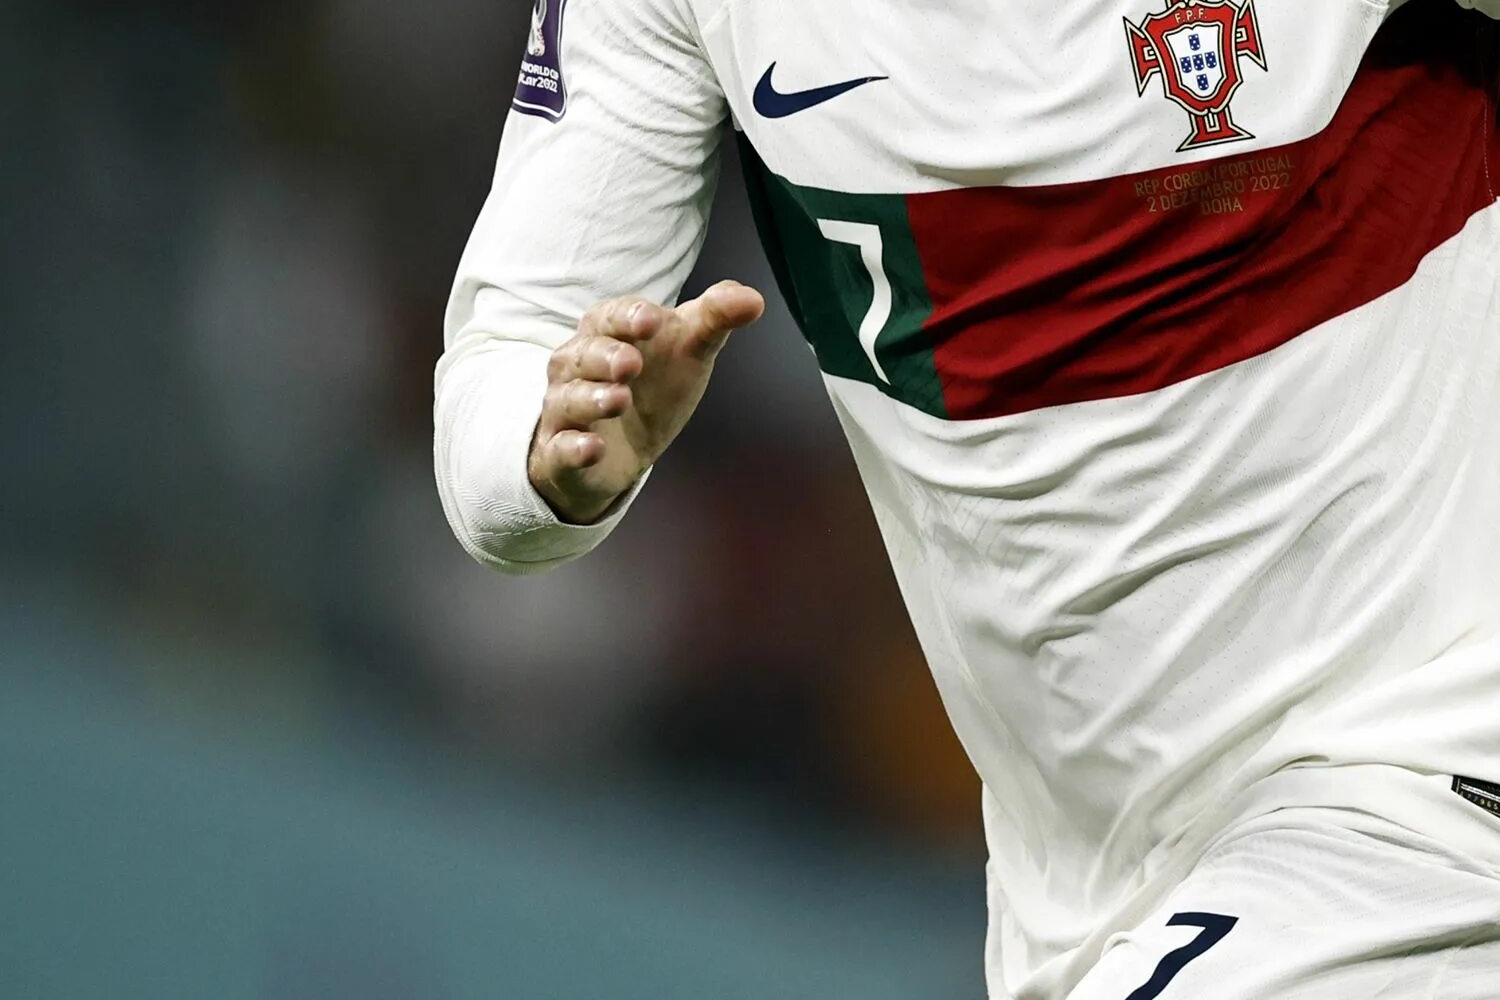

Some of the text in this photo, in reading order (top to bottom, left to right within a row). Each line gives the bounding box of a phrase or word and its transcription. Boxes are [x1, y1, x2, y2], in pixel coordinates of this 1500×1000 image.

[1146, 172, 1293, 212] 2 DEZEMBRO 2022
[1200, 196, 1244, 215] DOHA
[816, 218, 892, 386] 7
[1125, 912, 1239, 1000] 7
